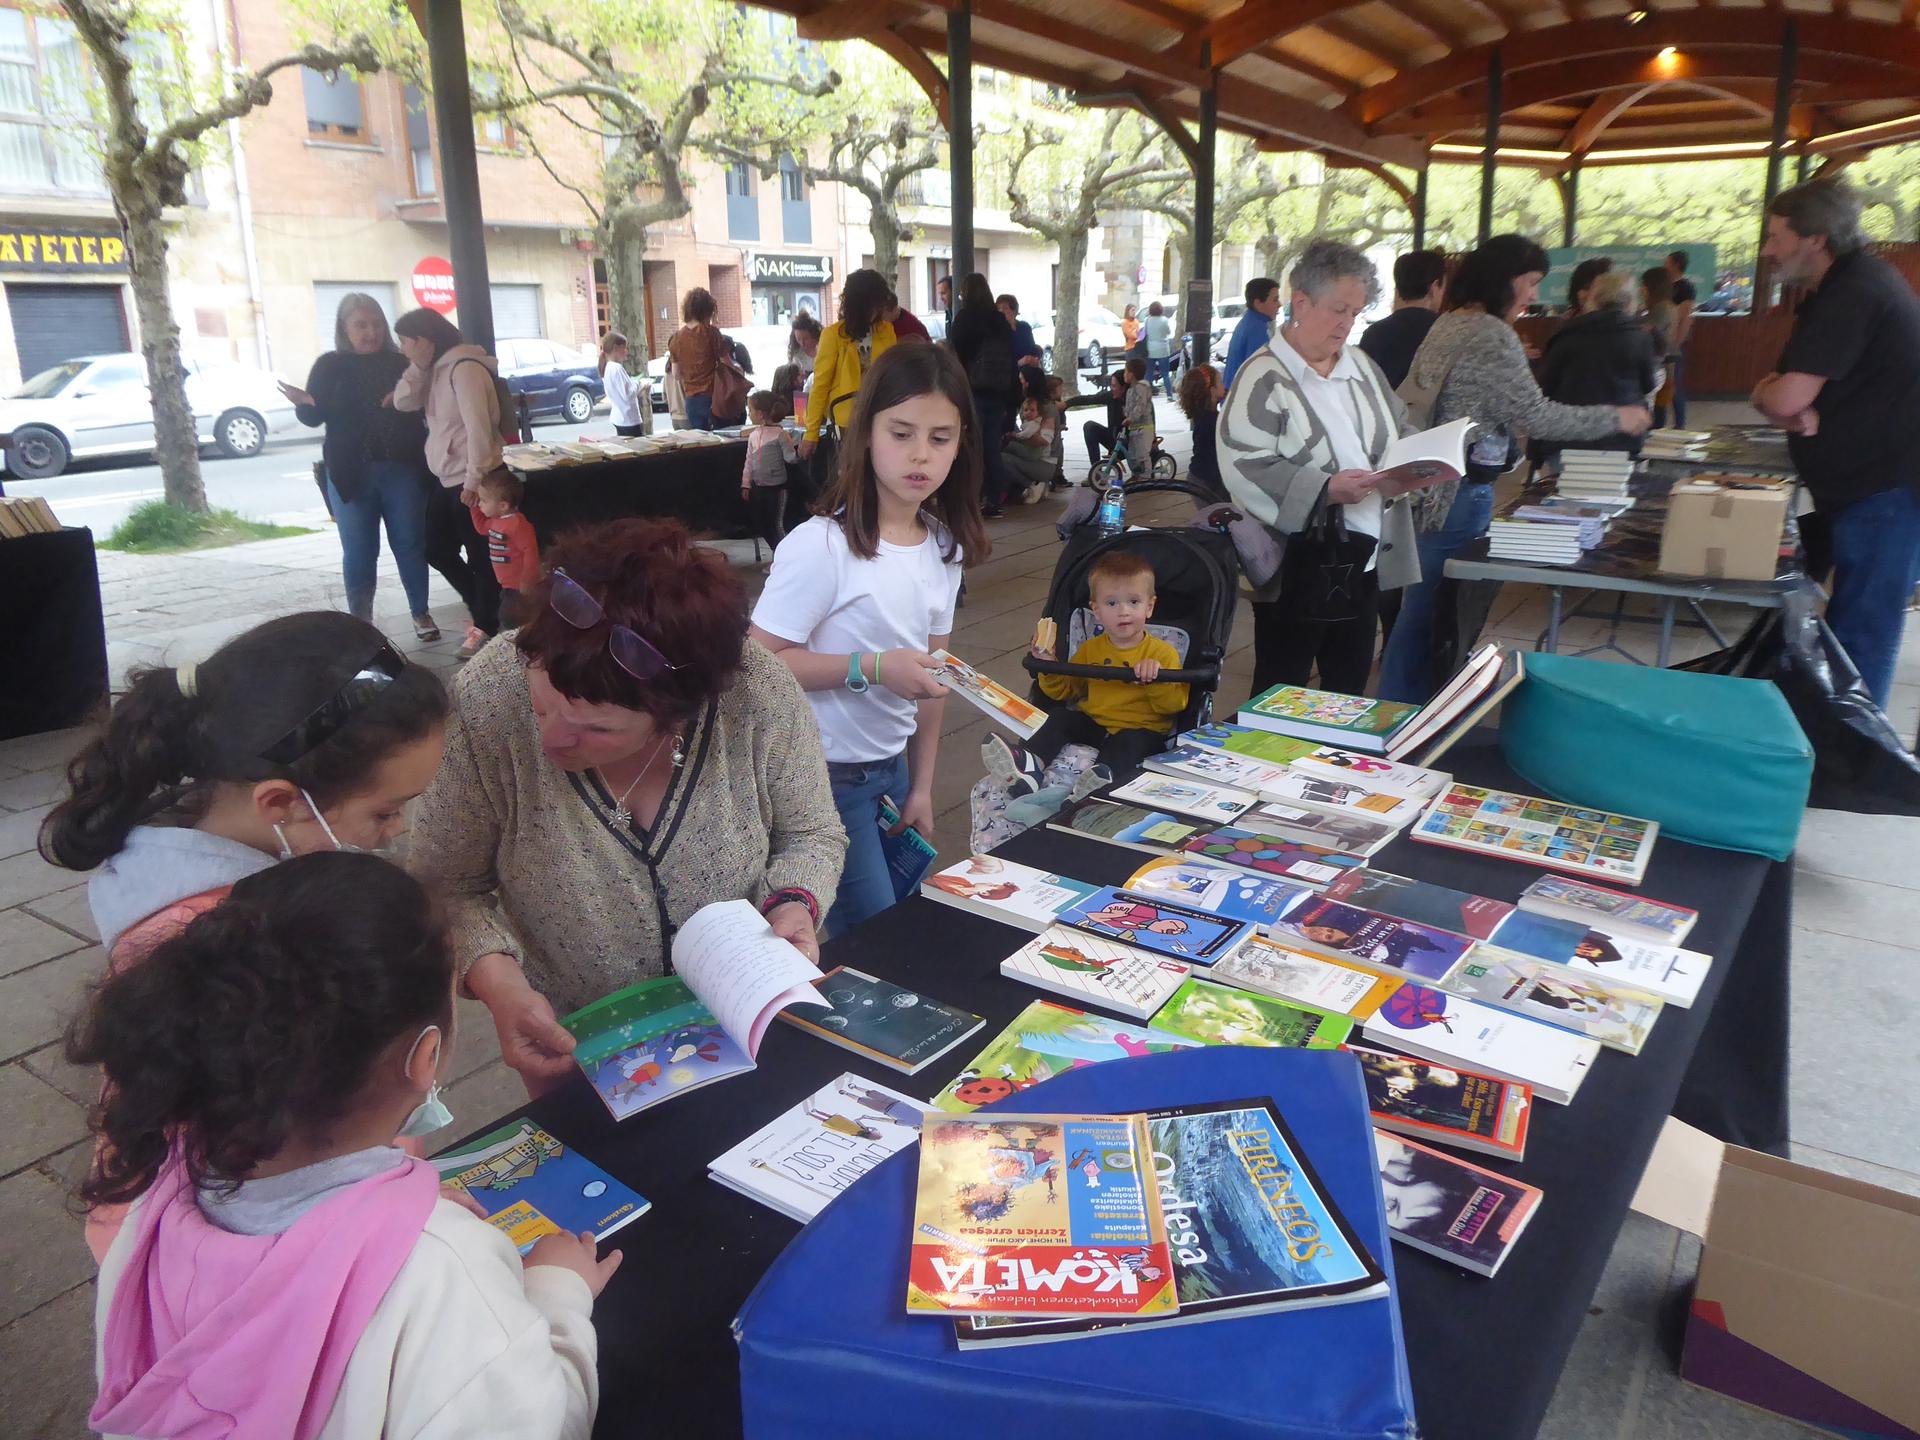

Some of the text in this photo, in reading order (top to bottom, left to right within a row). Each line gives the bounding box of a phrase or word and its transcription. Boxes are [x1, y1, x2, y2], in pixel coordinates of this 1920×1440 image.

[755, 258, 794, 277] ÑAKI
[811, 1131, 856, 1149] EL
[1231, 1128, 1333, 1264] PIRINEOS
[1152, 1150, 1208, 1267] Ordesa
[958, 1226, 1066, 1236] Zerrien erregea
[930, 1257, 1139, 1295] KOMETA
[986, 1294, 1139, 1307] irakurketaren bidean
